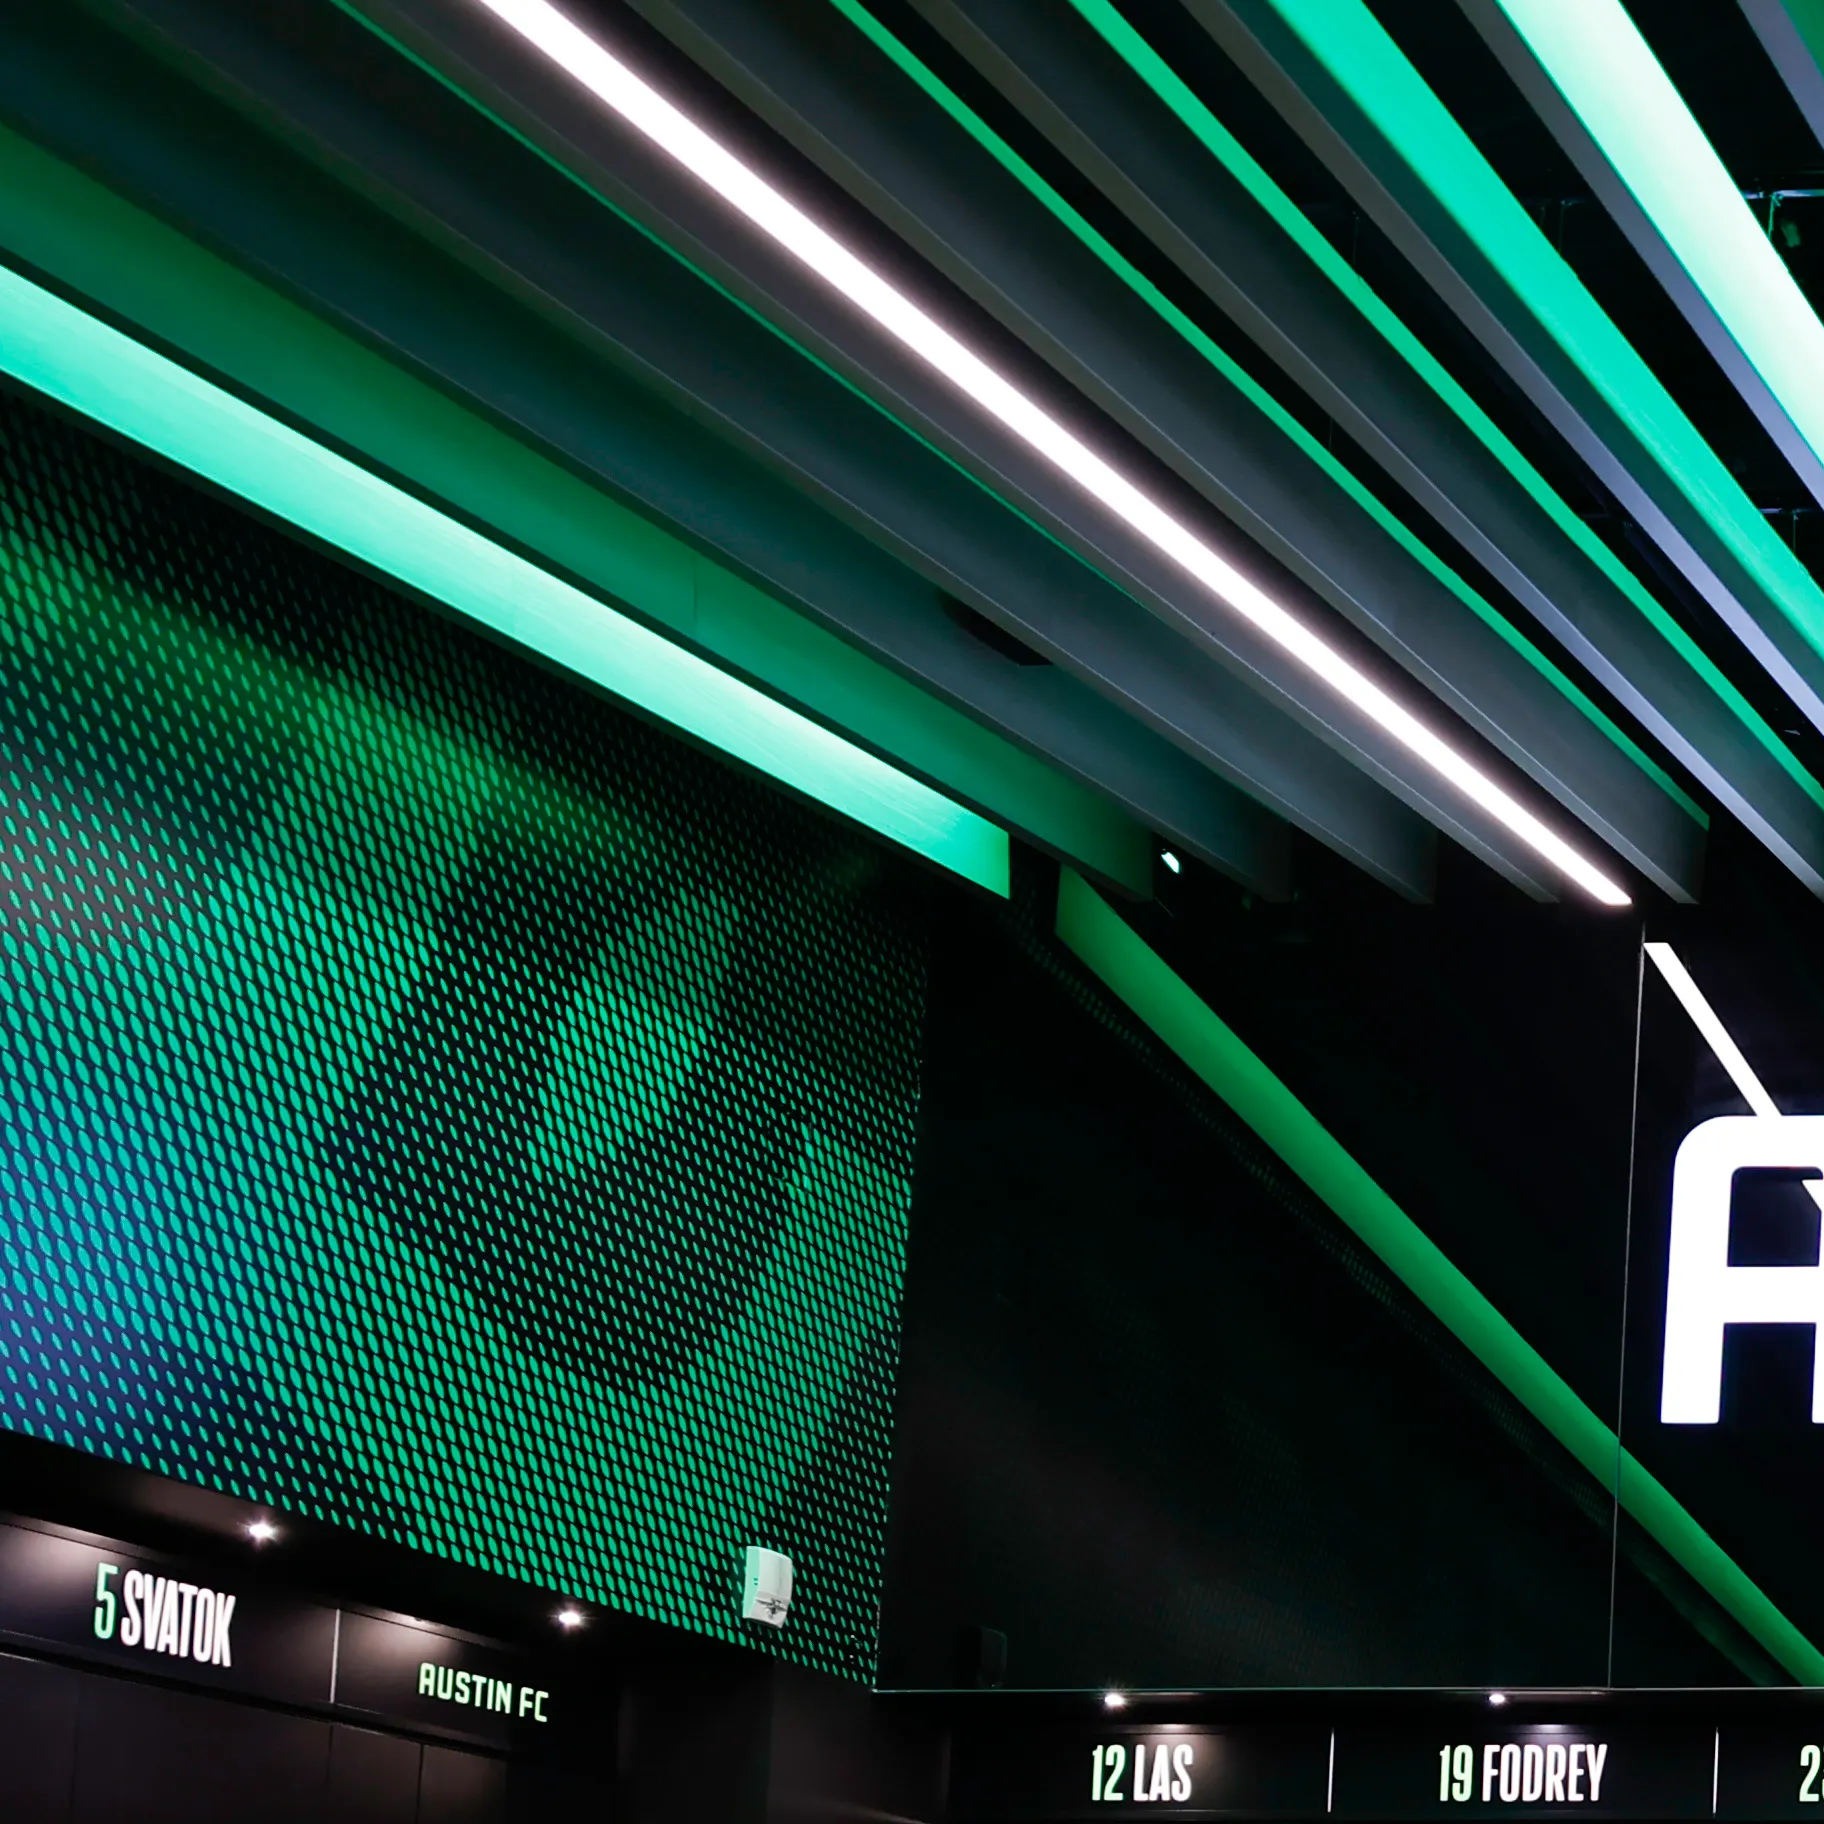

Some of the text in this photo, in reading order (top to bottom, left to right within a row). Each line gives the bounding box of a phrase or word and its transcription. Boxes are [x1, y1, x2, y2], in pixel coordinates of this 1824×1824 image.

[94, 1563, 236, 1667] 5 SVATOK
[418, 1662, 549, 1722] AUSTIN FC
[1091, 1744, 1193, 1802] 12 LAS
[1439, 1744, 1608, 1802] 19 FODREY
